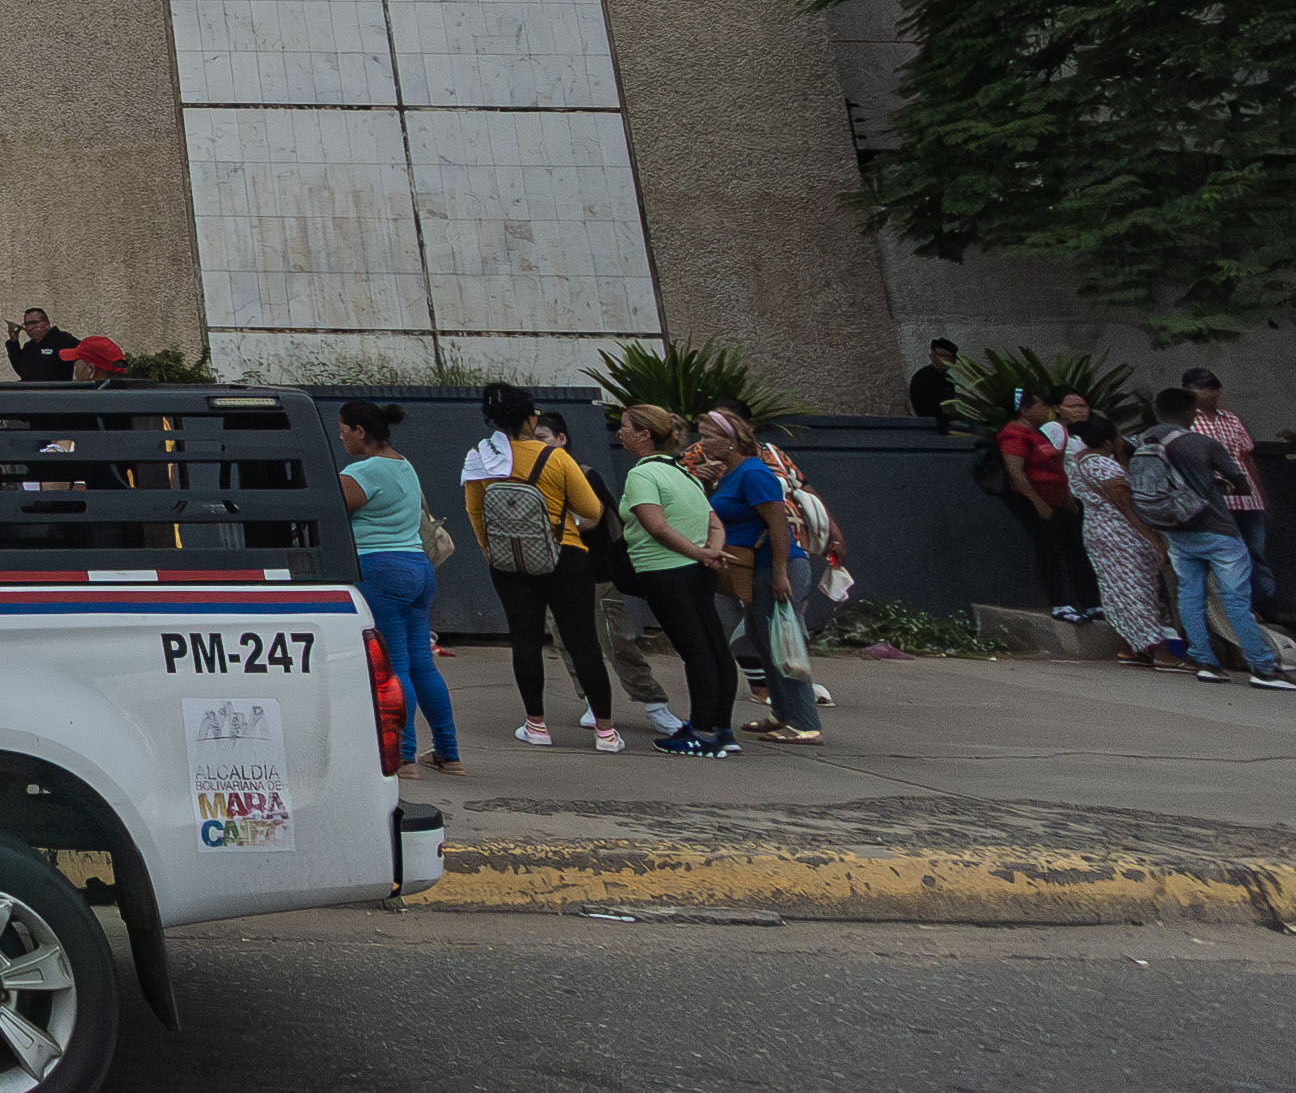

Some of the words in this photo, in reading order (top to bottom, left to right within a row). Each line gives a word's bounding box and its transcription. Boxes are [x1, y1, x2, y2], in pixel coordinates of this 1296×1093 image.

[160, 632, 315, 673] PM-247
[195, 780, 266, 791] BOLIVARIANA
[268, 780, 282, 791] DE
